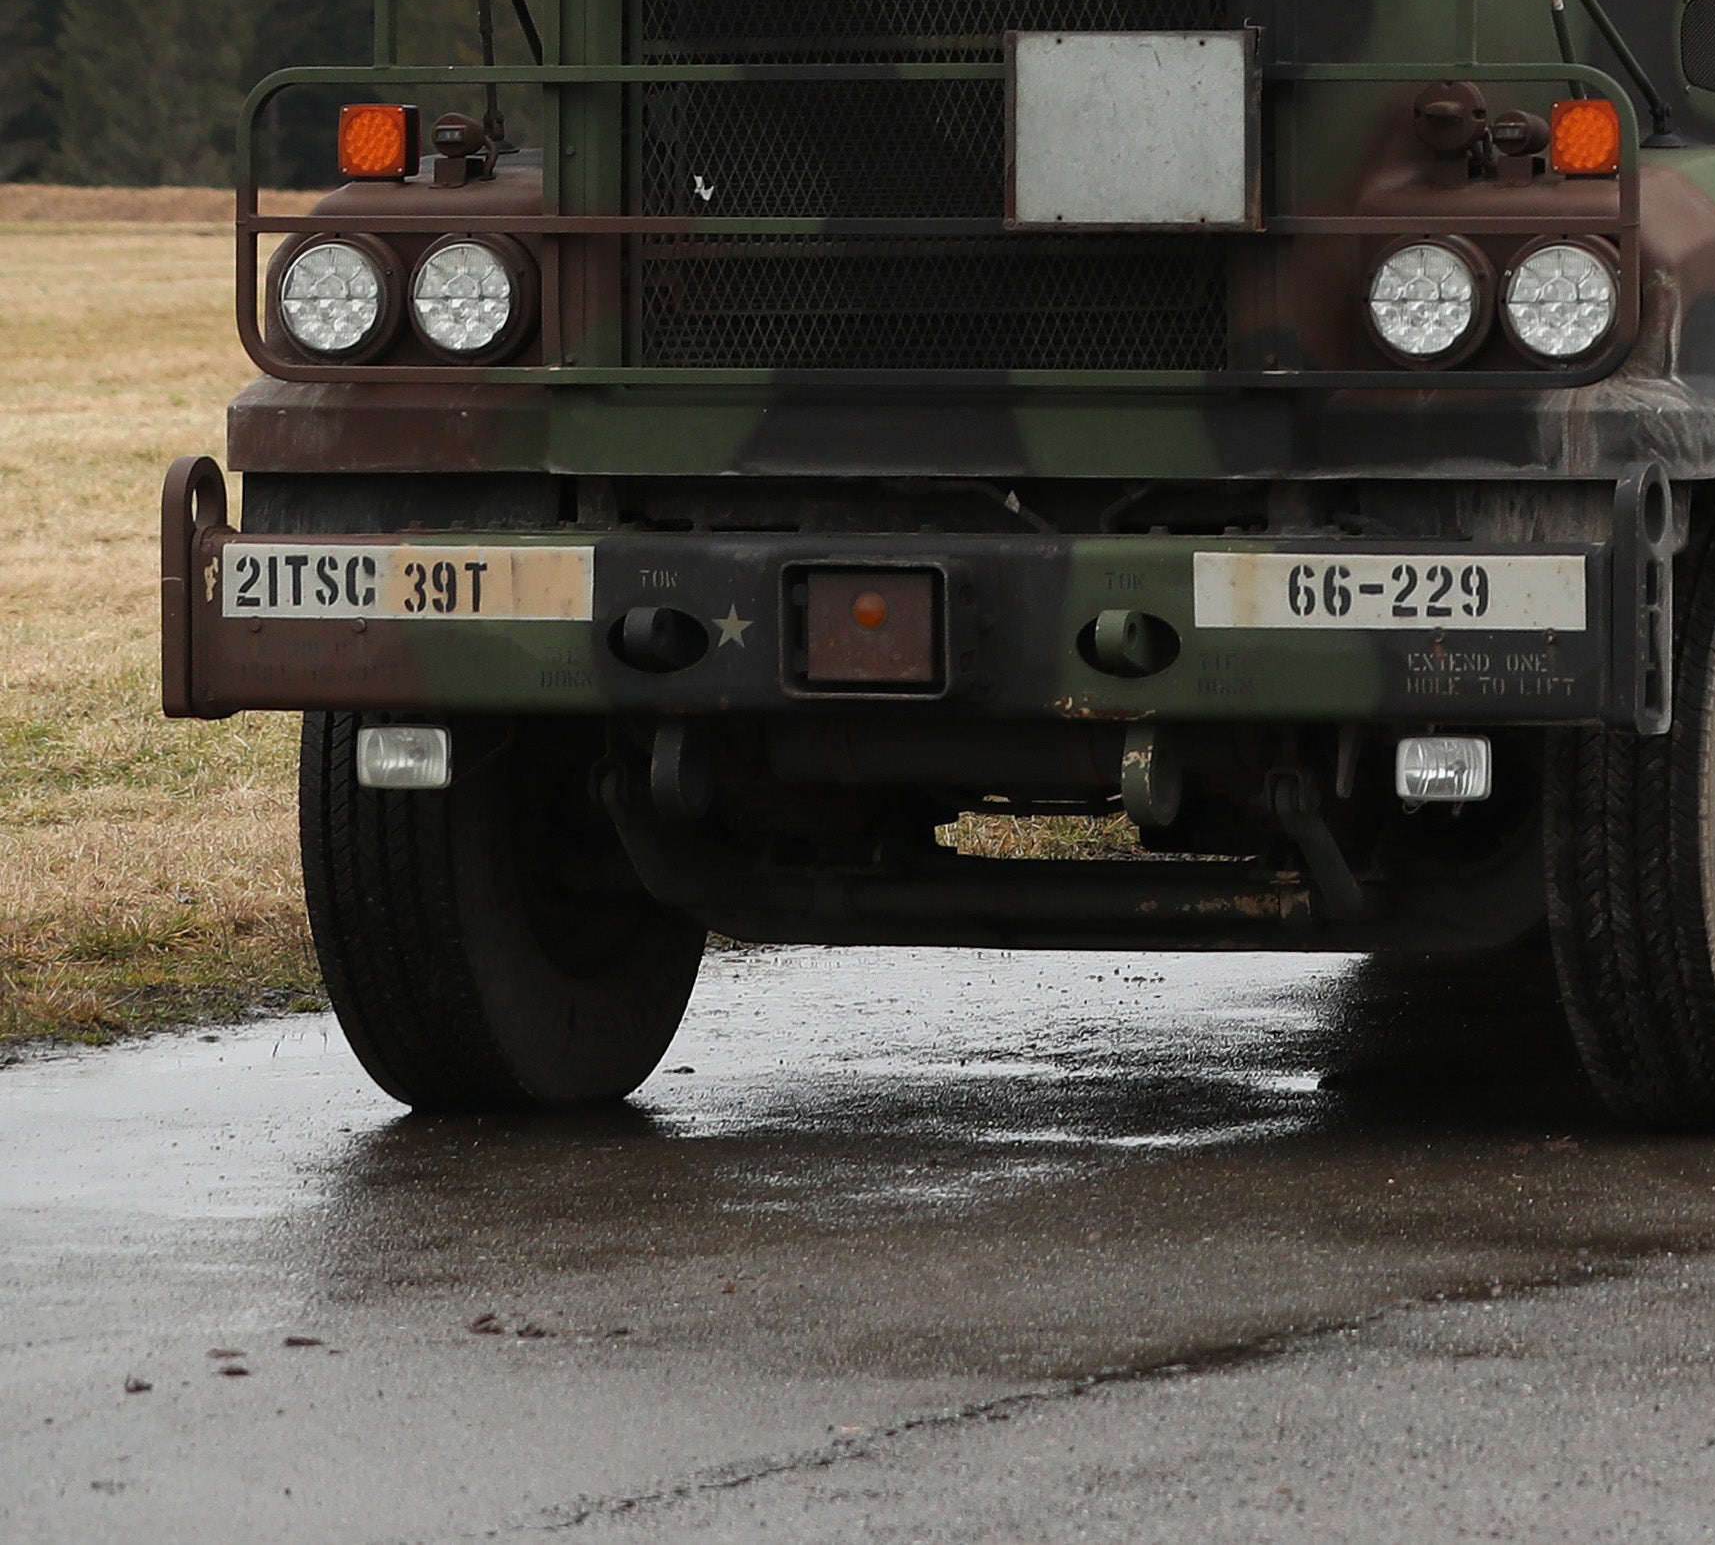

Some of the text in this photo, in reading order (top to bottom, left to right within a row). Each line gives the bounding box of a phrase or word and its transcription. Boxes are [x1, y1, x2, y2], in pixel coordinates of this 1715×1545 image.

[403, 562, 488, 613] 39T
[1288, 565, 1489, 617] 66-229
[1407, 653, 1548, 674] EXTEND ONE
[1479, 676, 1505, 697] TO
[1519, 676, 1575, 698] LIFT
